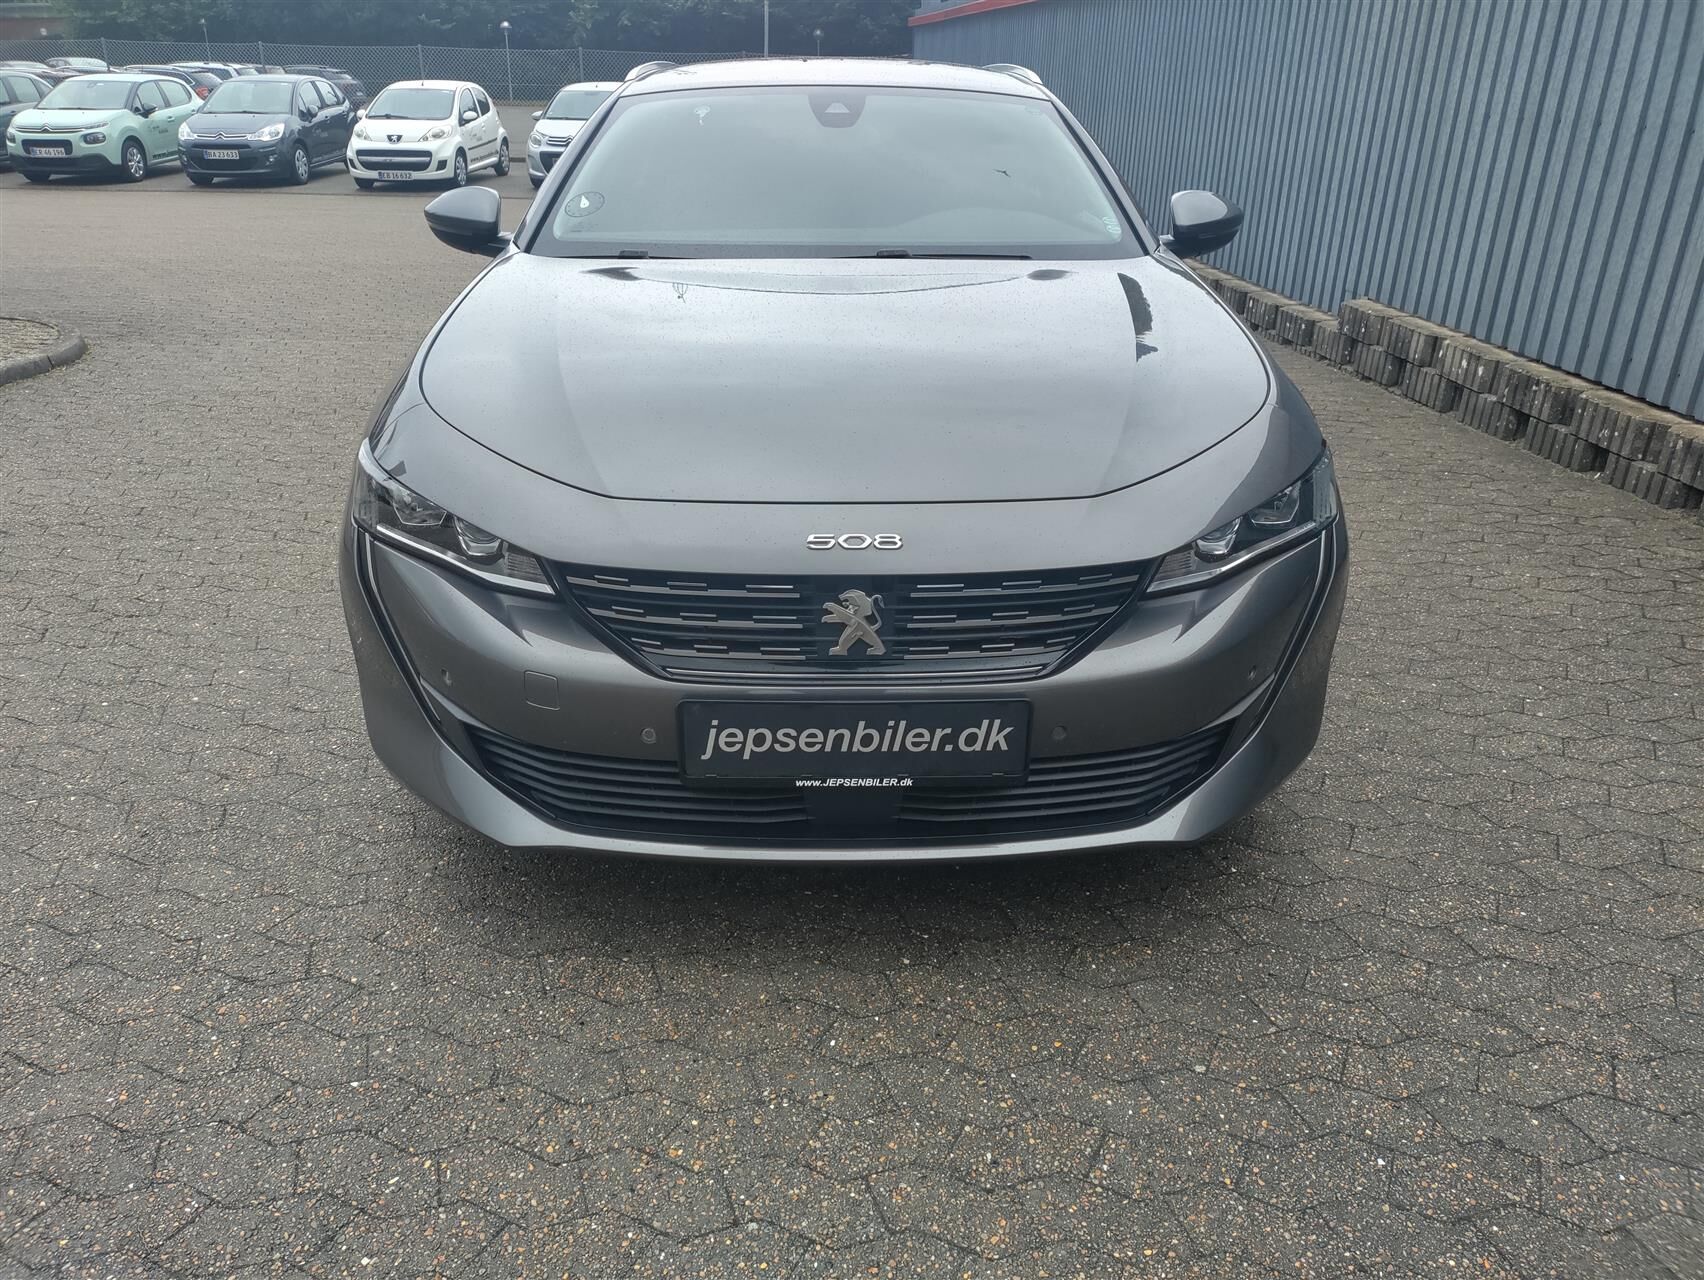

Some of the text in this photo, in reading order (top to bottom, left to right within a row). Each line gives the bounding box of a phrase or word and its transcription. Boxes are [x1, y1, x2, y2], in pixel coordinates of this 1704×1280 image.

[217, 151, 226, 159] 23
[226, 151, 239, 159] 633
[806, 533, 903, 550] 508
[700, 719, 1014, 760] jepsenbiler.dk
[795, 776, 914, 788] www.JEPSENBILER.dk
